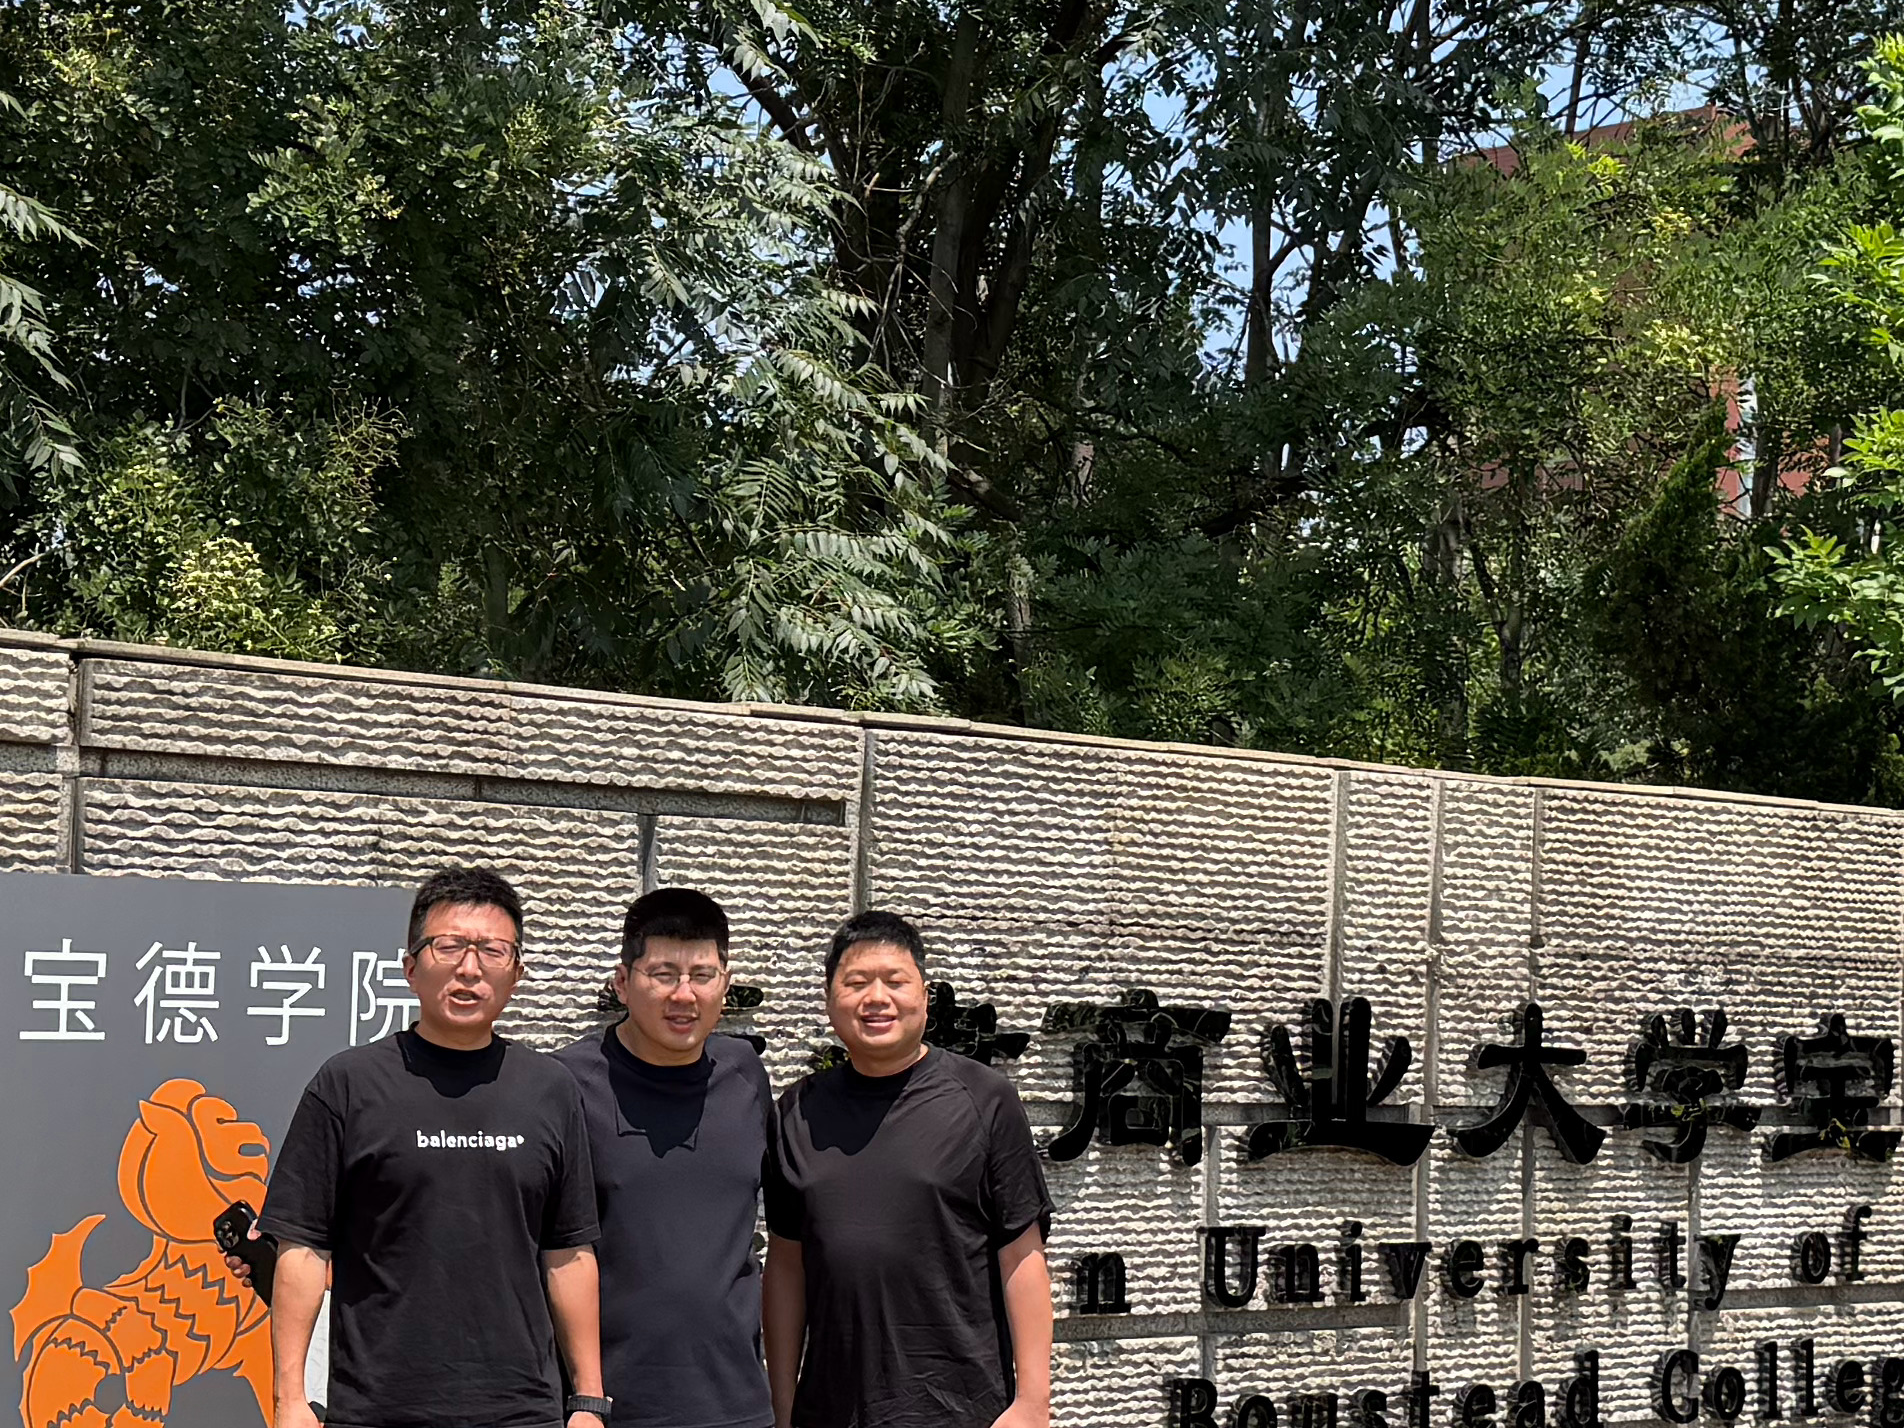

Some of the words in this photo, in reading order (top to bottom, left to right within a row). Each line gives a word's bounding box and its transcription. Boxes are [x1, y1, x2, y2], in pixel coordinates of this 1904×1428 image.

[416, 1129, 518, 1151] balenciaga
[1198, 1215, 1741, 1310] University
[1800, 1206, 1871, 1283] of
